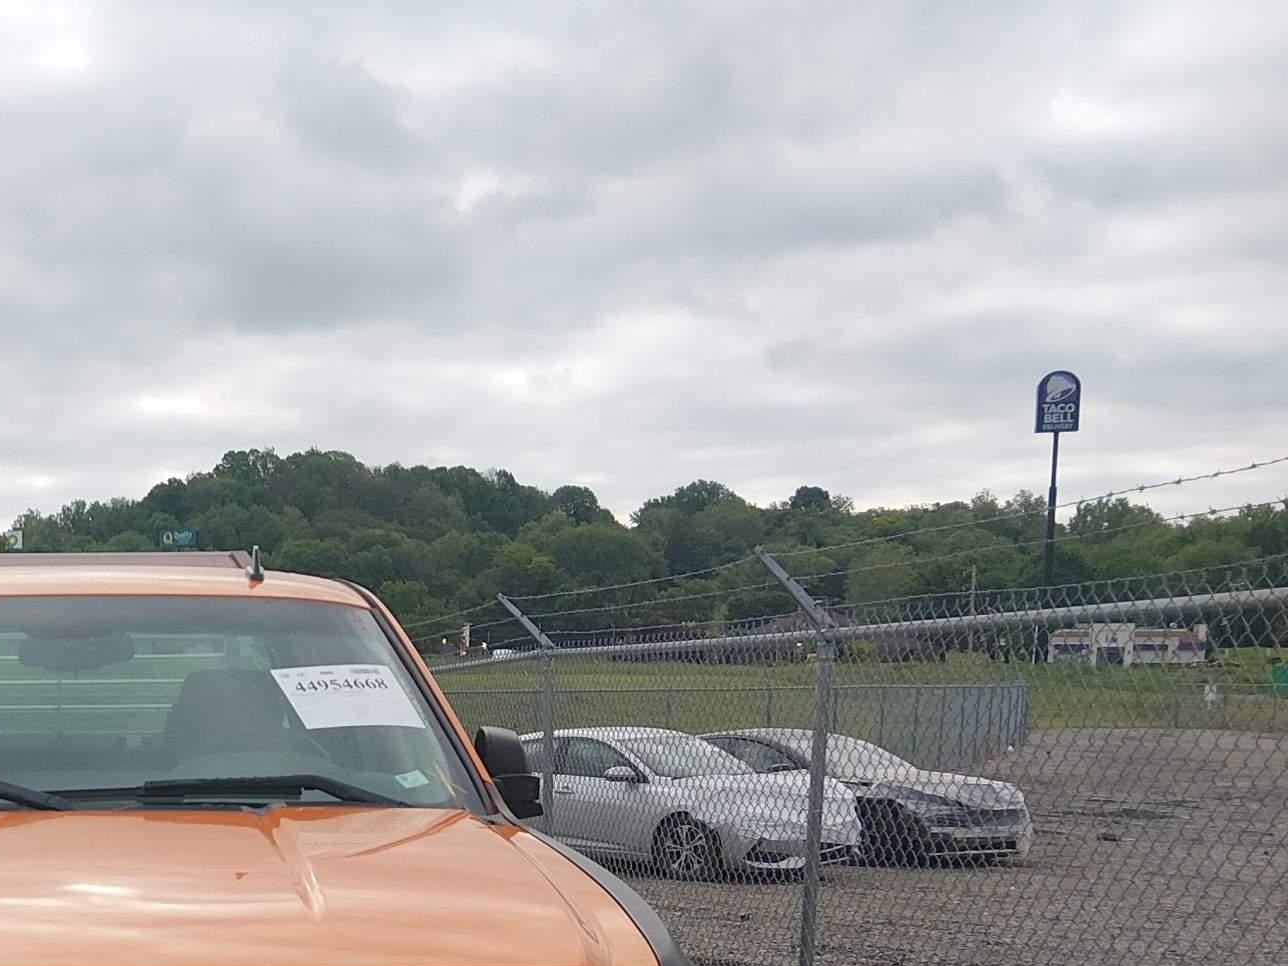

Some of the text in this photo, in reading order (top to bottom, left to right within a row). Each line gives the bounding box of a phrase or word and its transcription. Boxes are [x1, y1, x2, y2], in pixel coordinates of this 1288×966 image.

[1042, 403, 1076, 413] TACO
[1044, 413, 1074, 423] BELL
[295, 678, 389, 693] 44954668
